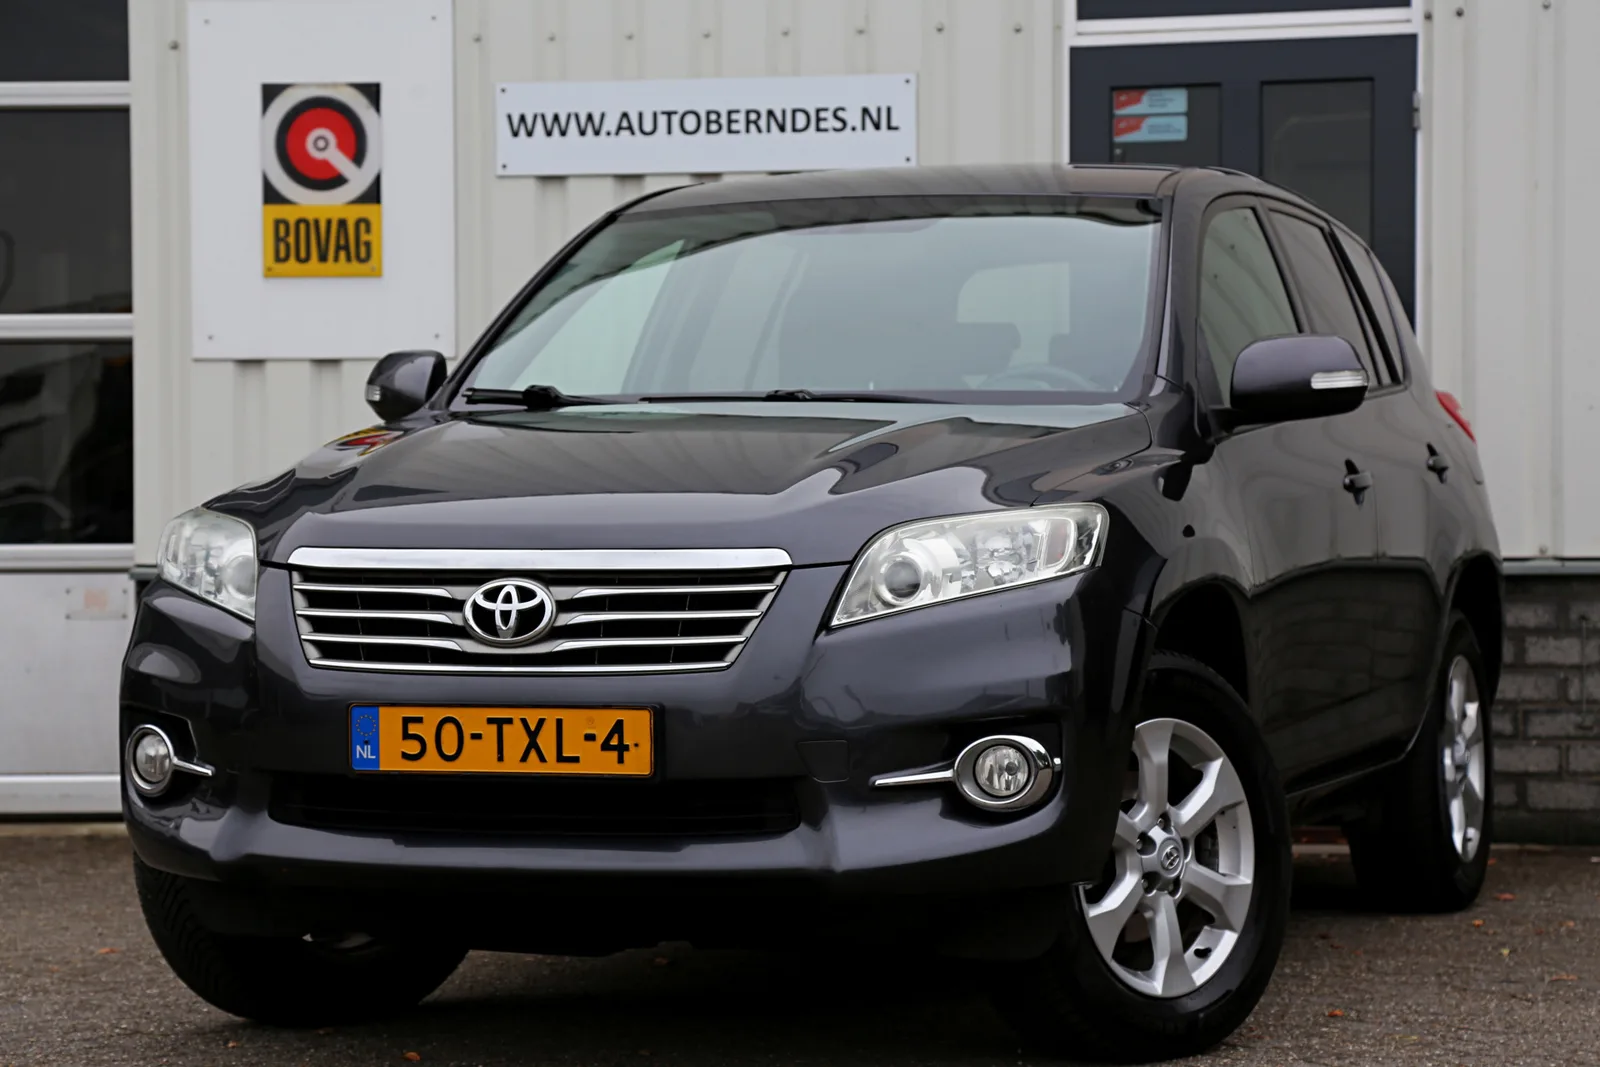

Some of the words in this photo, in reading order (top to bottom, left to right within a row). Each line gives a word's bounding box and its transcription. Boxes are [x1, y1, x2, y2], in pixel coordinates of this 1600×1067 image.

[507, 106, 900, 138] WWW.AUTOBERNDES.NL
[273, 217, 372, 264] BOVAG
[355, 744, 376, 759] NL
[400, 715, 630, 764] 50-TXL-4
